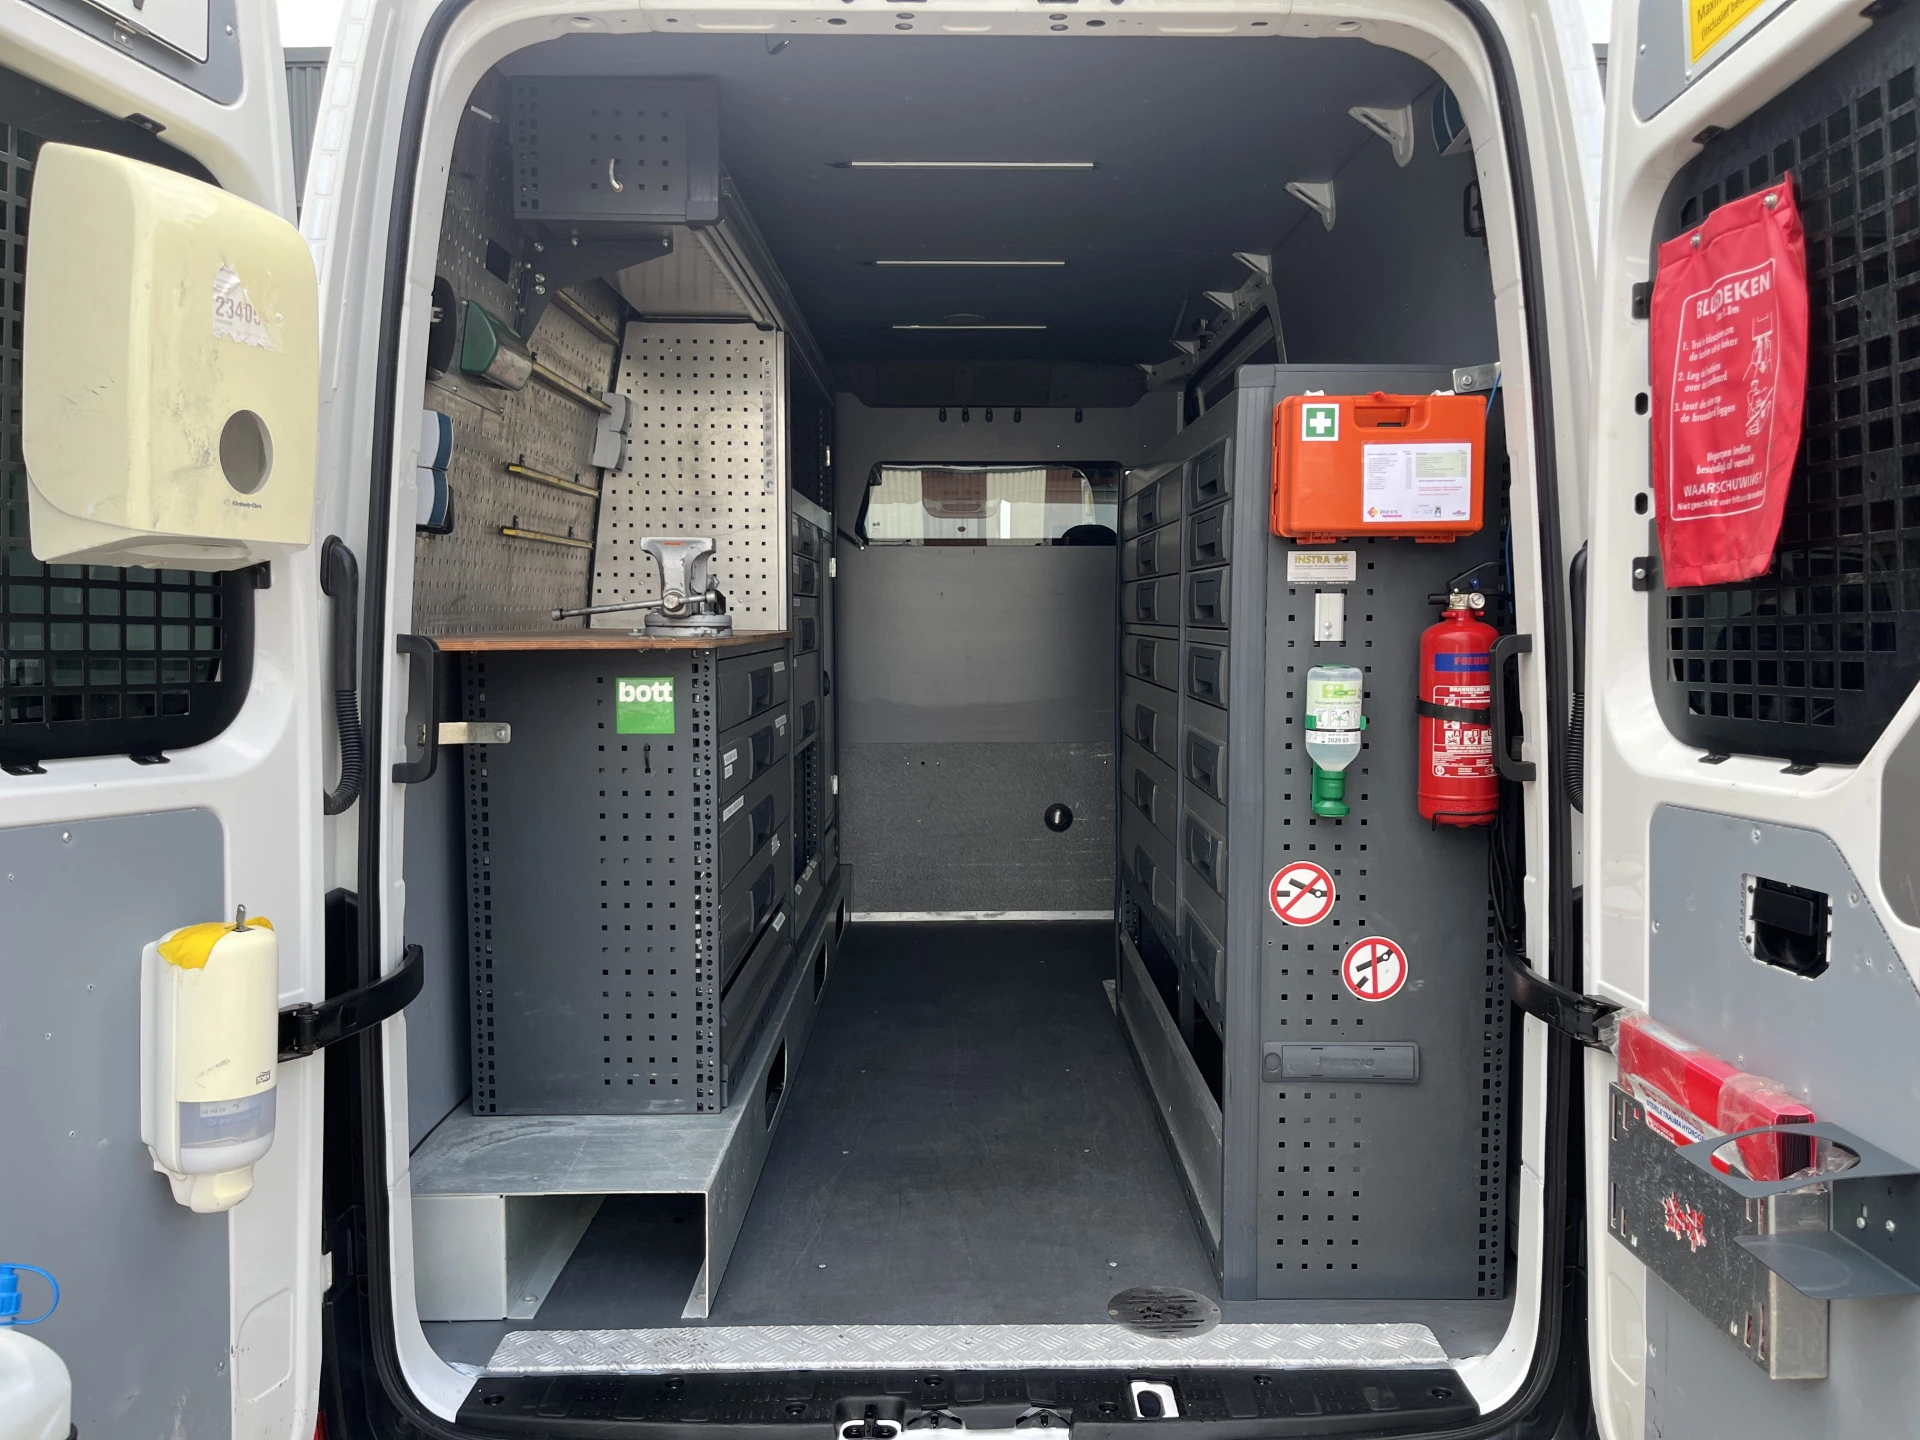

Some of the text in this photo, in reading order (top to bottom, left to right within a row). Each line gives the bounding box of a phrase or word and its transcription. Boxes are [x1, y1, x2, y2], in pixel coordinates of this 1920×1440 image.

[1687, 371, 1700, 382] Leg
[1684, 384, 1701, 392] over
[1294, 555, 1331, 564] INSTRA
[618, 681, 673, 703] bott
[1663, 1110, 1681, 1129] TRAUMA
